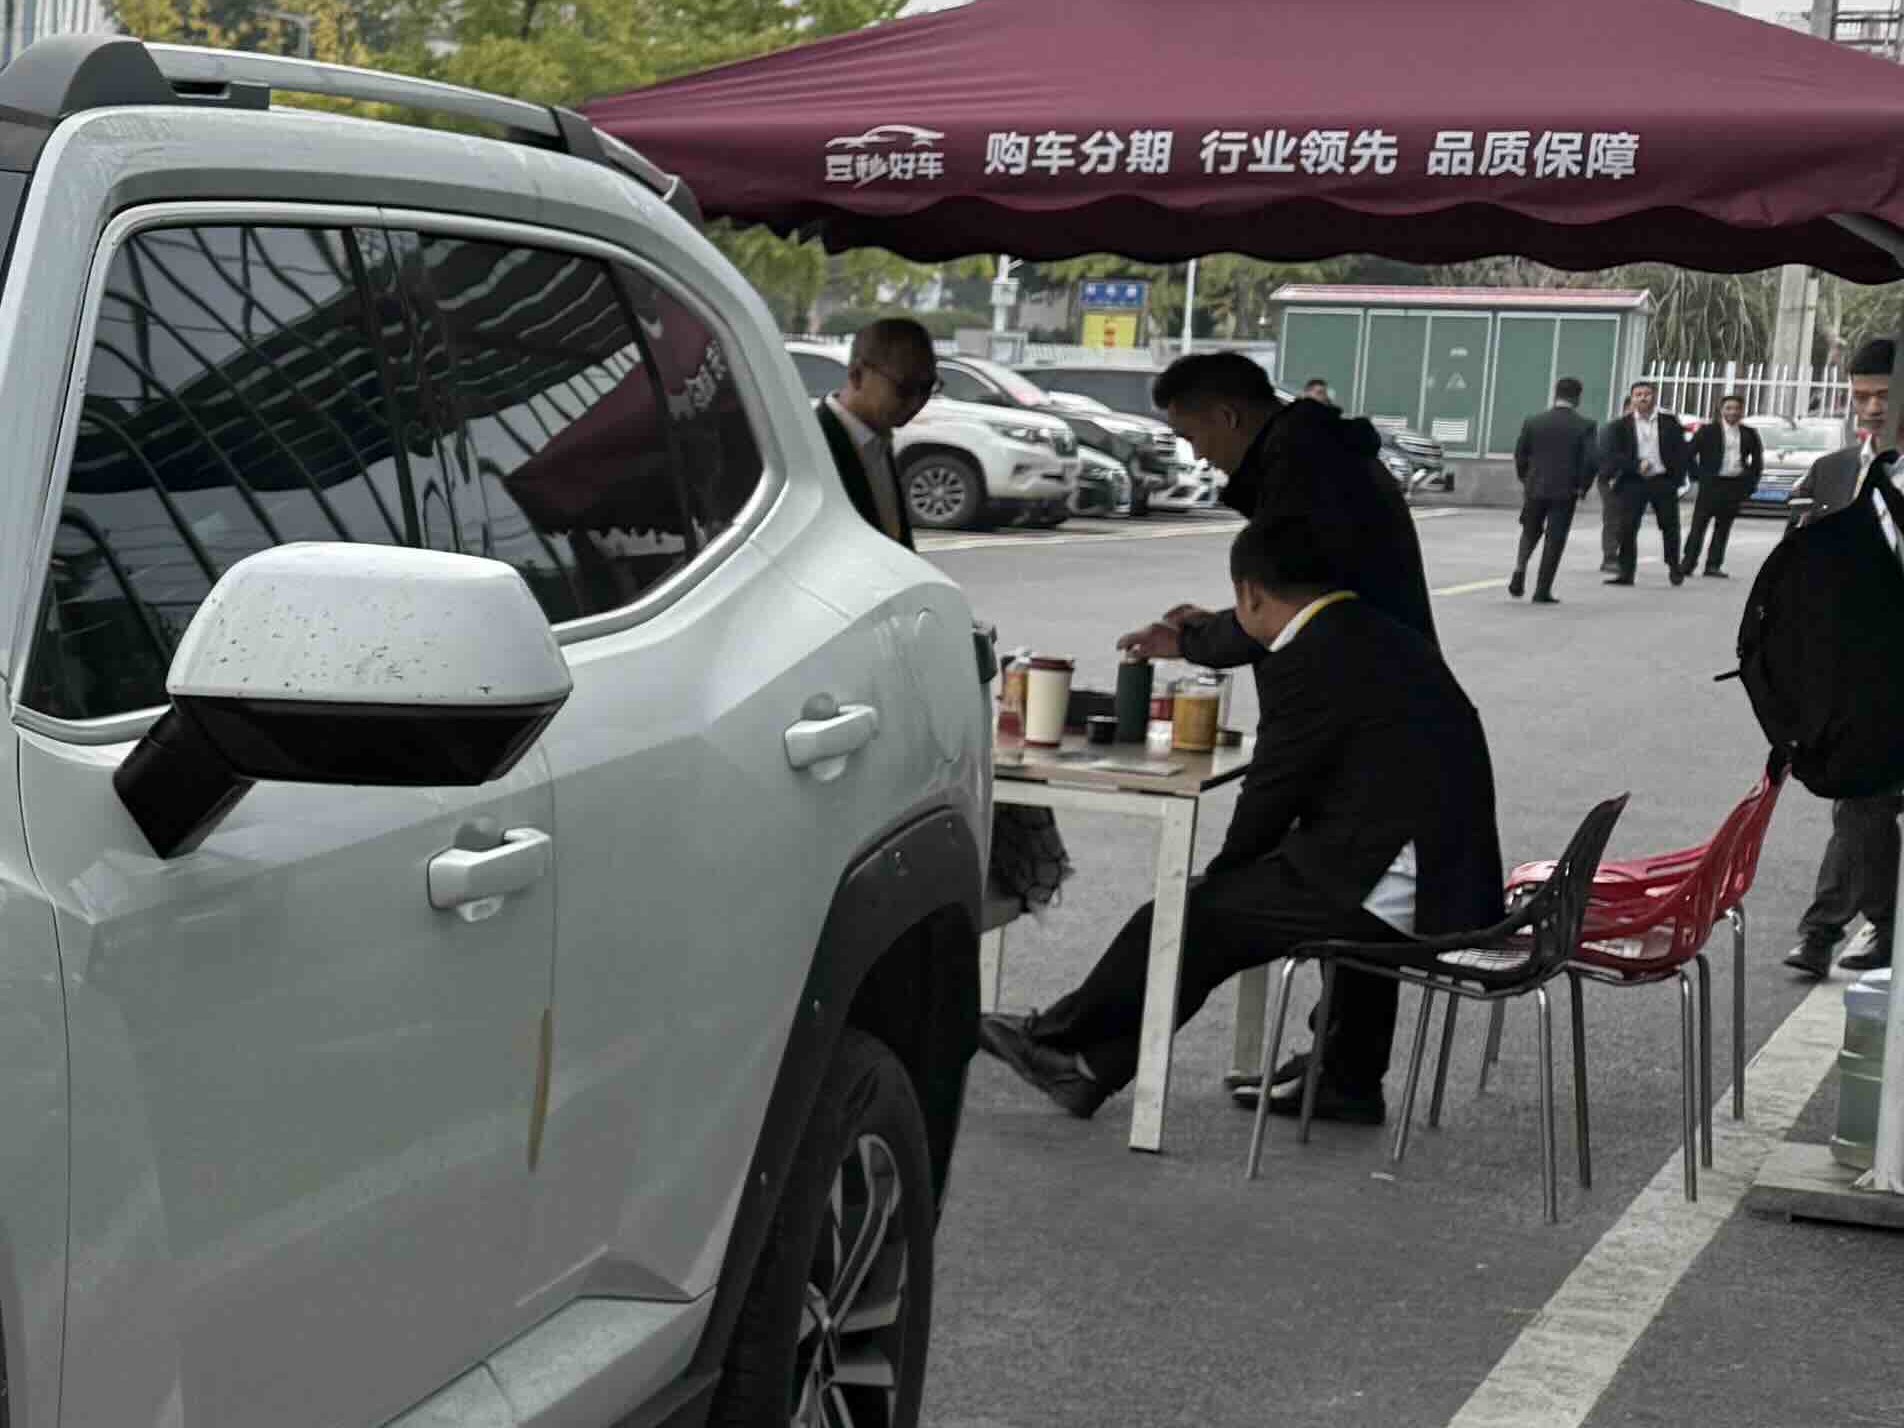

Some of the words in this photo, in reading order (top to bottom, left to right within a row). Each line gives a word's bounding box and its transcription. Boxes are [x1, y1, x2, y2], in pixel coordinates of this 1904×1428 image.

[985, 130, 1173, 174] 购车分期
[1199, 129, 1398, 174] 行业领先
[1426, 130, 1640, 179] 品质保障
